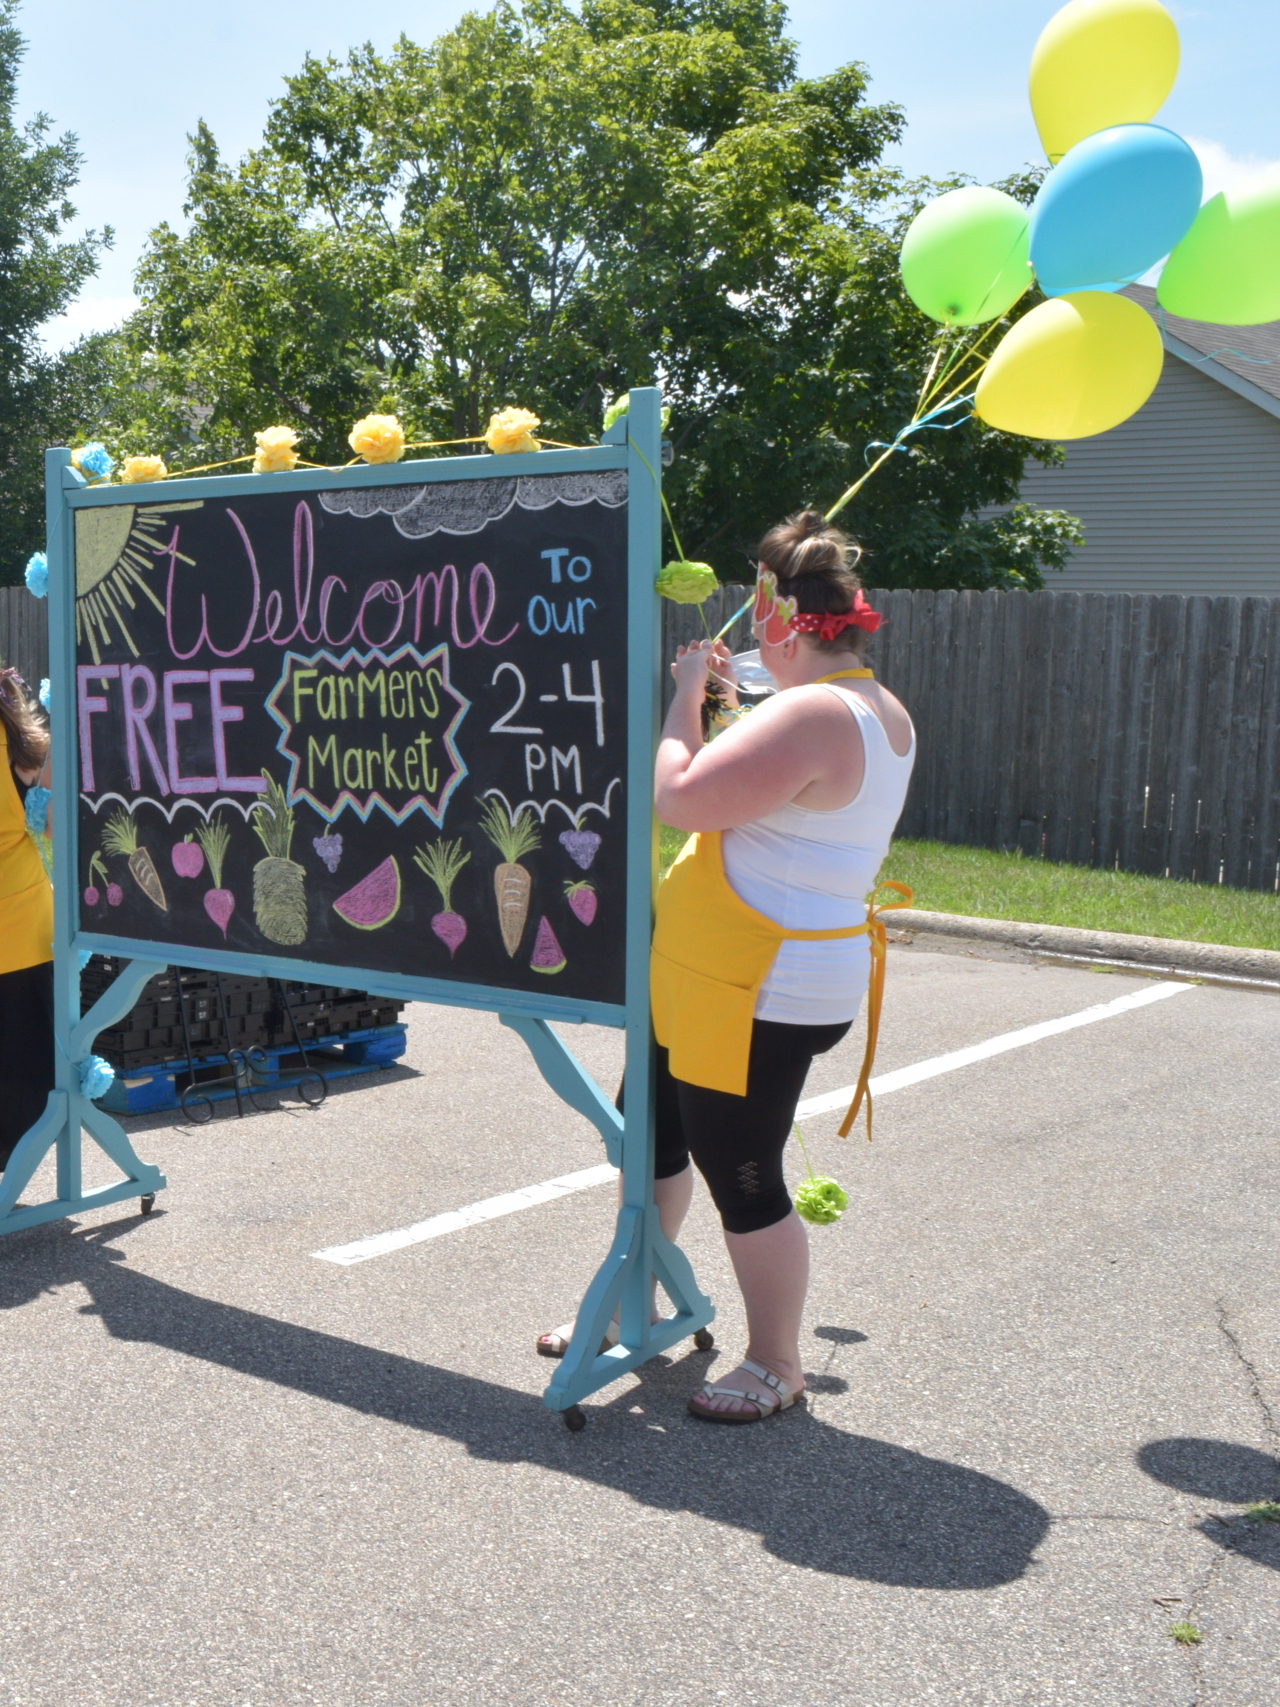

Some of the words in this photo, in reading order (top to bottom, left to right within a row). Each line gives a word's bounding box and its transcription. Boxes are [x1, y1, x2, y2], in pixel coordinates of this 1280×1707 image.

[152, 500, 519, 660] Welcome
[540, 548, 592, 584] To
[77, 663, 268, 797] FREE
[308, 730, 438, 793] Market
[525, 743, 582, 794] PM
